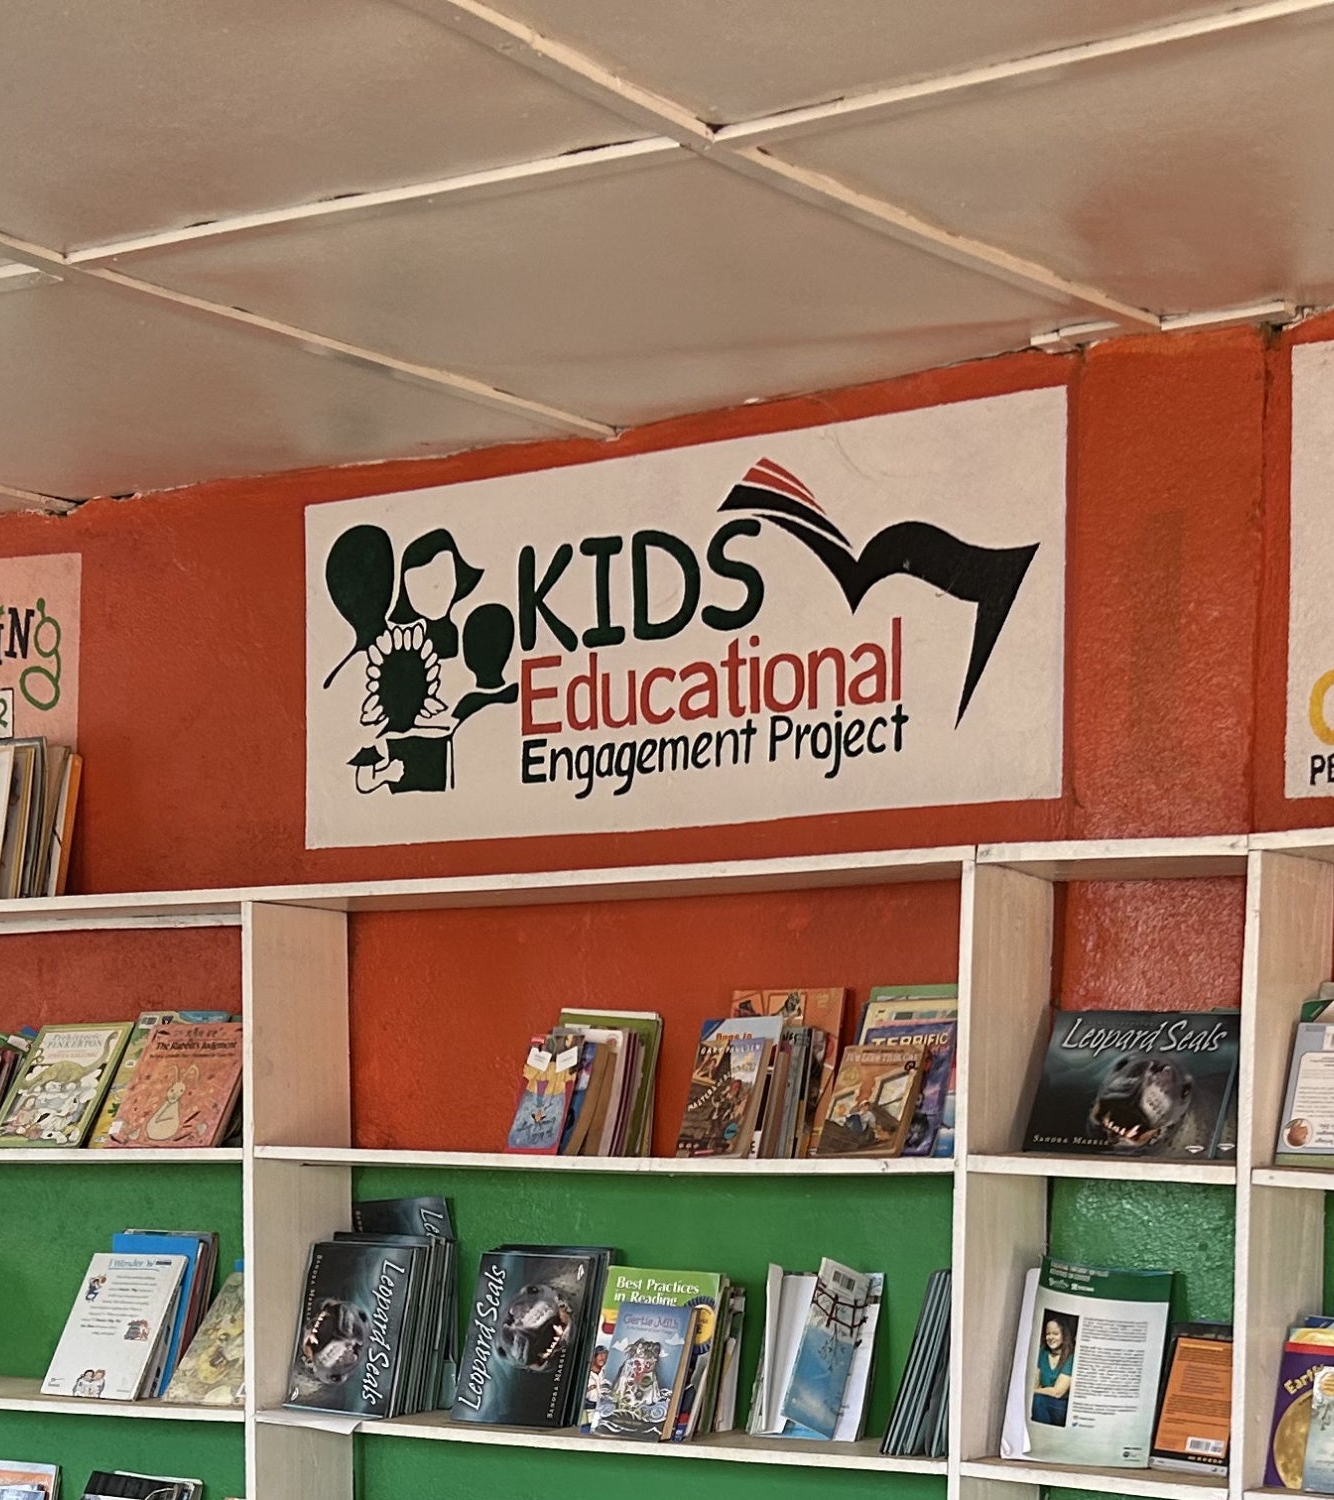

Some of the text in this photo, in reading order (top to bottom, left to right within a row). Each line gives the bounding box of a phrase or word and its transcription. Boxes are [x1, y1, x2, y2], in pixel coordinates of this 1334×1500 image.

[518, 518, 765, 653] KIDS
[521, 617, 903, 735] Educational
[521, 703, 910, 800] Engagement Project
[1061, 1018, 1227, 1057] Leopard Seals
[361, 1258, 405, 1406] Leopard Seals
[614, 1289, 678, 1307] in Reading
[617, 1276, 700, 1295] Best Practices
[623, 1314, 654, 1326] Gertie
[457, 1263, 507, 1411] Leopard Seals
